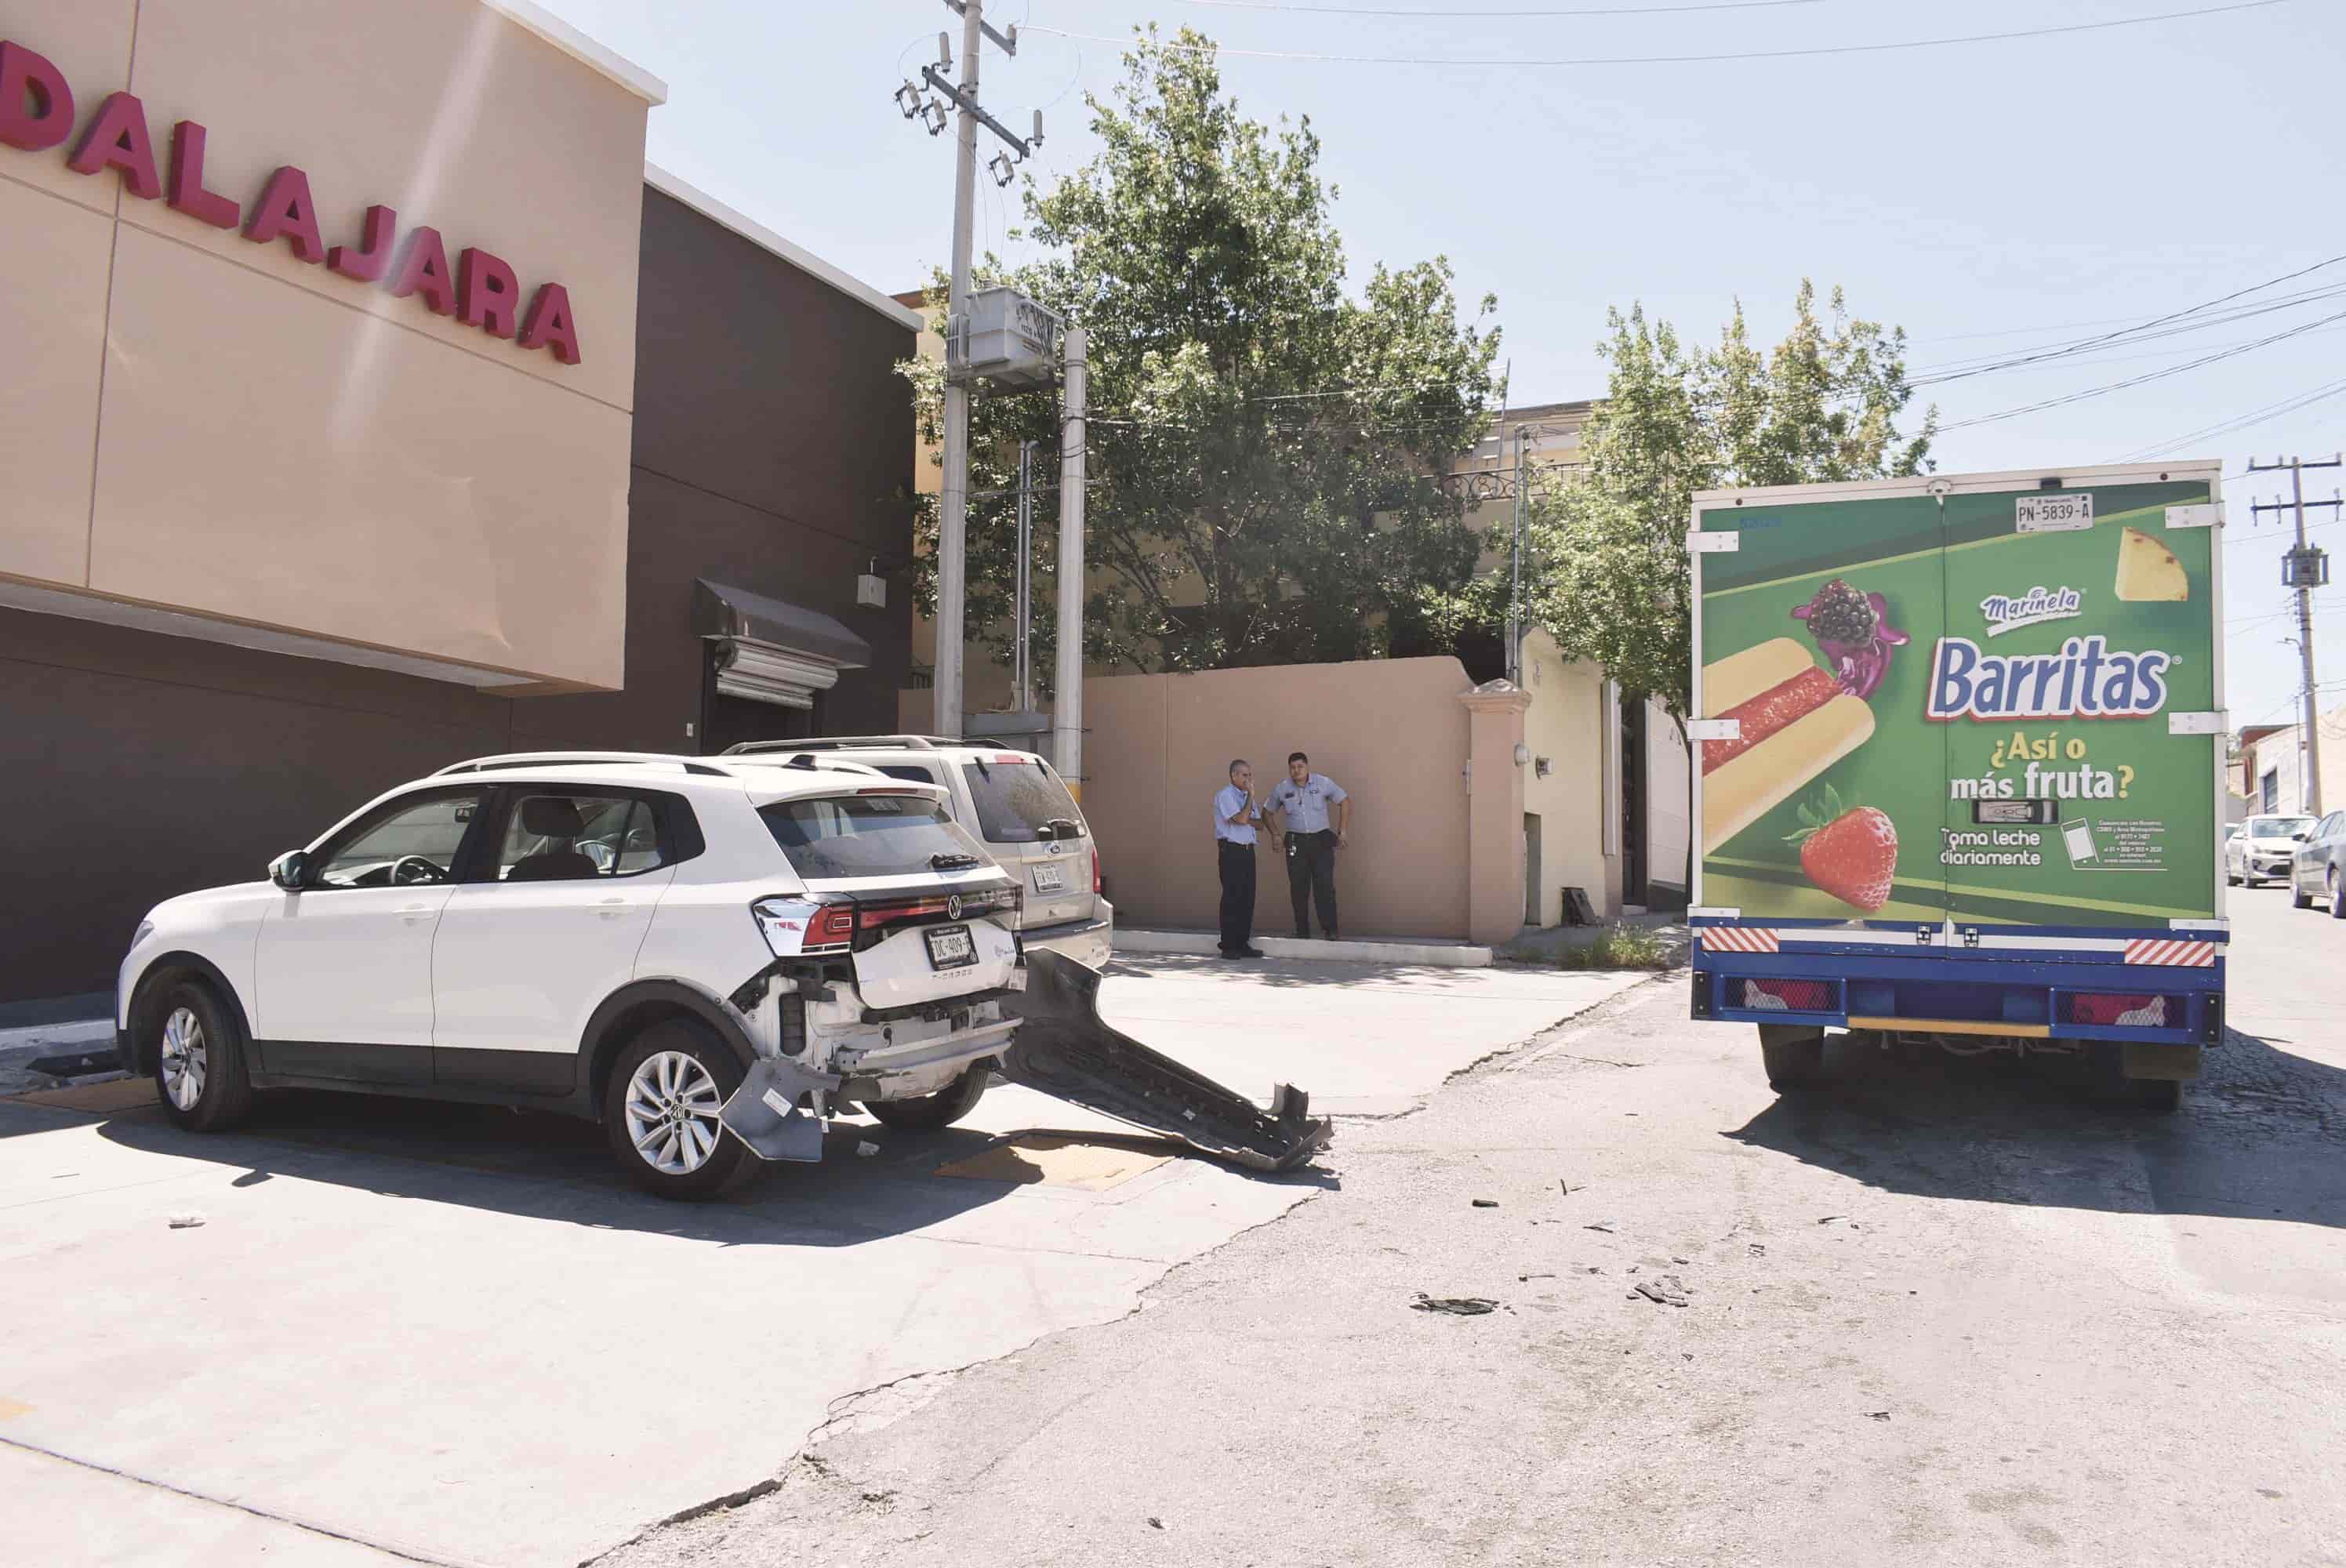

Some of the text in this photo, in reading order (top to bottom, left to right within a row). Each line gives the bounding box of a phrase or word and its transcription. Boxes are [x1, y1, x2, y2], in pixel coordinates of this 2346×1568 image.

[2018, 503, 2090, 522] PN-5839-A
[1981, 588, 2079, 621] Marinela
[1931, 637, 2167, 714] Barritas
[1991, 731, 2086, 768] ¿Así o
[1950, 761, 2135, 799] más fruta?
[1940, 827, 2041, 848] Toma leche
[1940, 849, 2042, 866] diariamente
